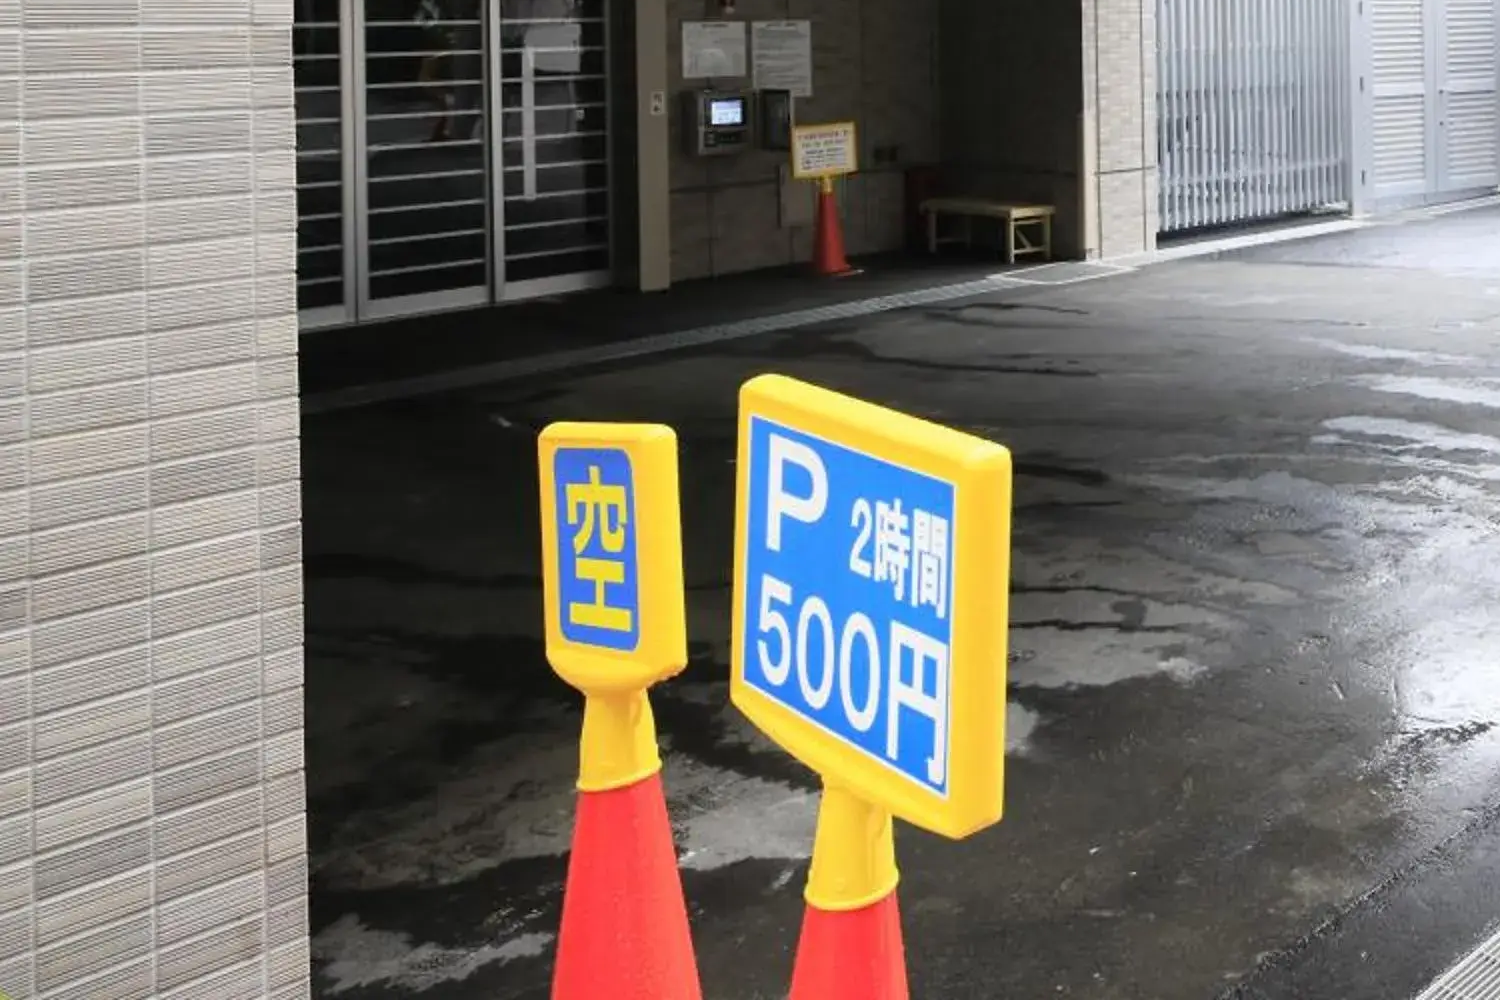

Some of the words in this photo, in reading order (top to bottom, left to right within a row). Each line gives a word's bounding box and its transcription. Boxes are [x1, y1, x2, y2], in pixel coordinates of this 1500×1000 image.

[565, 465, 633, 633] 空
[765, 432, 829, 552] P
[848, 496, 949, 618] 2時間
[757, 572, 949, 786] 500円
